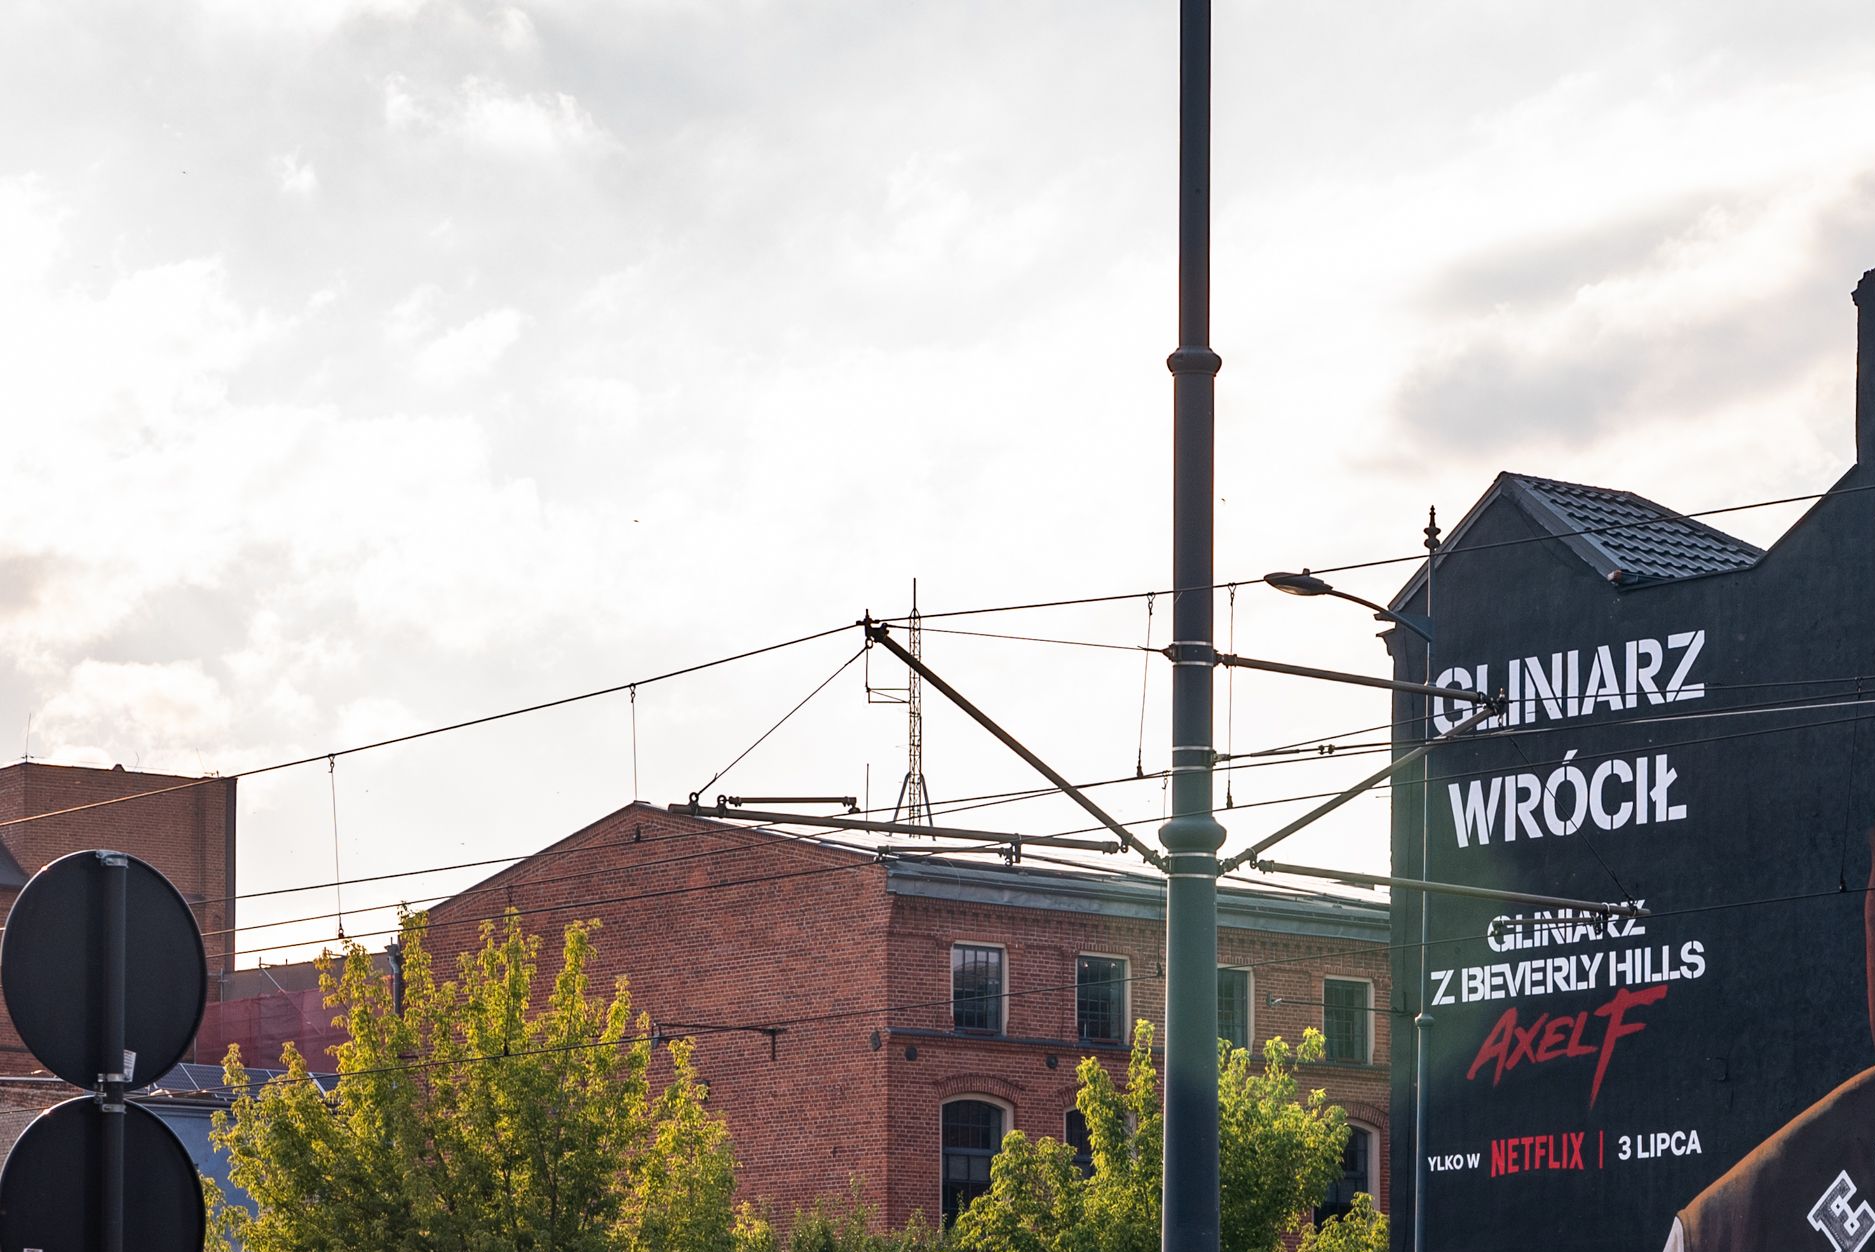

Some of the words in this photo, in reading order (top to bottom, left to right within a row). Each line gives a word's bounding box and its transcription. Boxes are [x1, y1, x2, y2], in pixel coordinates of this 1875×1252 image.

[1433, 629, 1705, 735] GLINIARZ
[1447, 749, 1687, 848] WRÓCIŁ
[1487, 899, 1646, 952] GLINIARZ
[1430, 969, 1455, 1006] Z
[1461, 952, 1604, 1002] BEVERLY
[1609, 940, 1706, 986] HILLS
[1589, 985, 1668, 1110] F
[1427, 1153, 1464, 1172] YLKO
[1466, 1152, 1480, 1169] W
[1490, 1132, 1585, 1178] NETFLIX
[1618, 1136, 1632, 1161] 3
[1637, 1130, 1702, 1159] LIPCA
